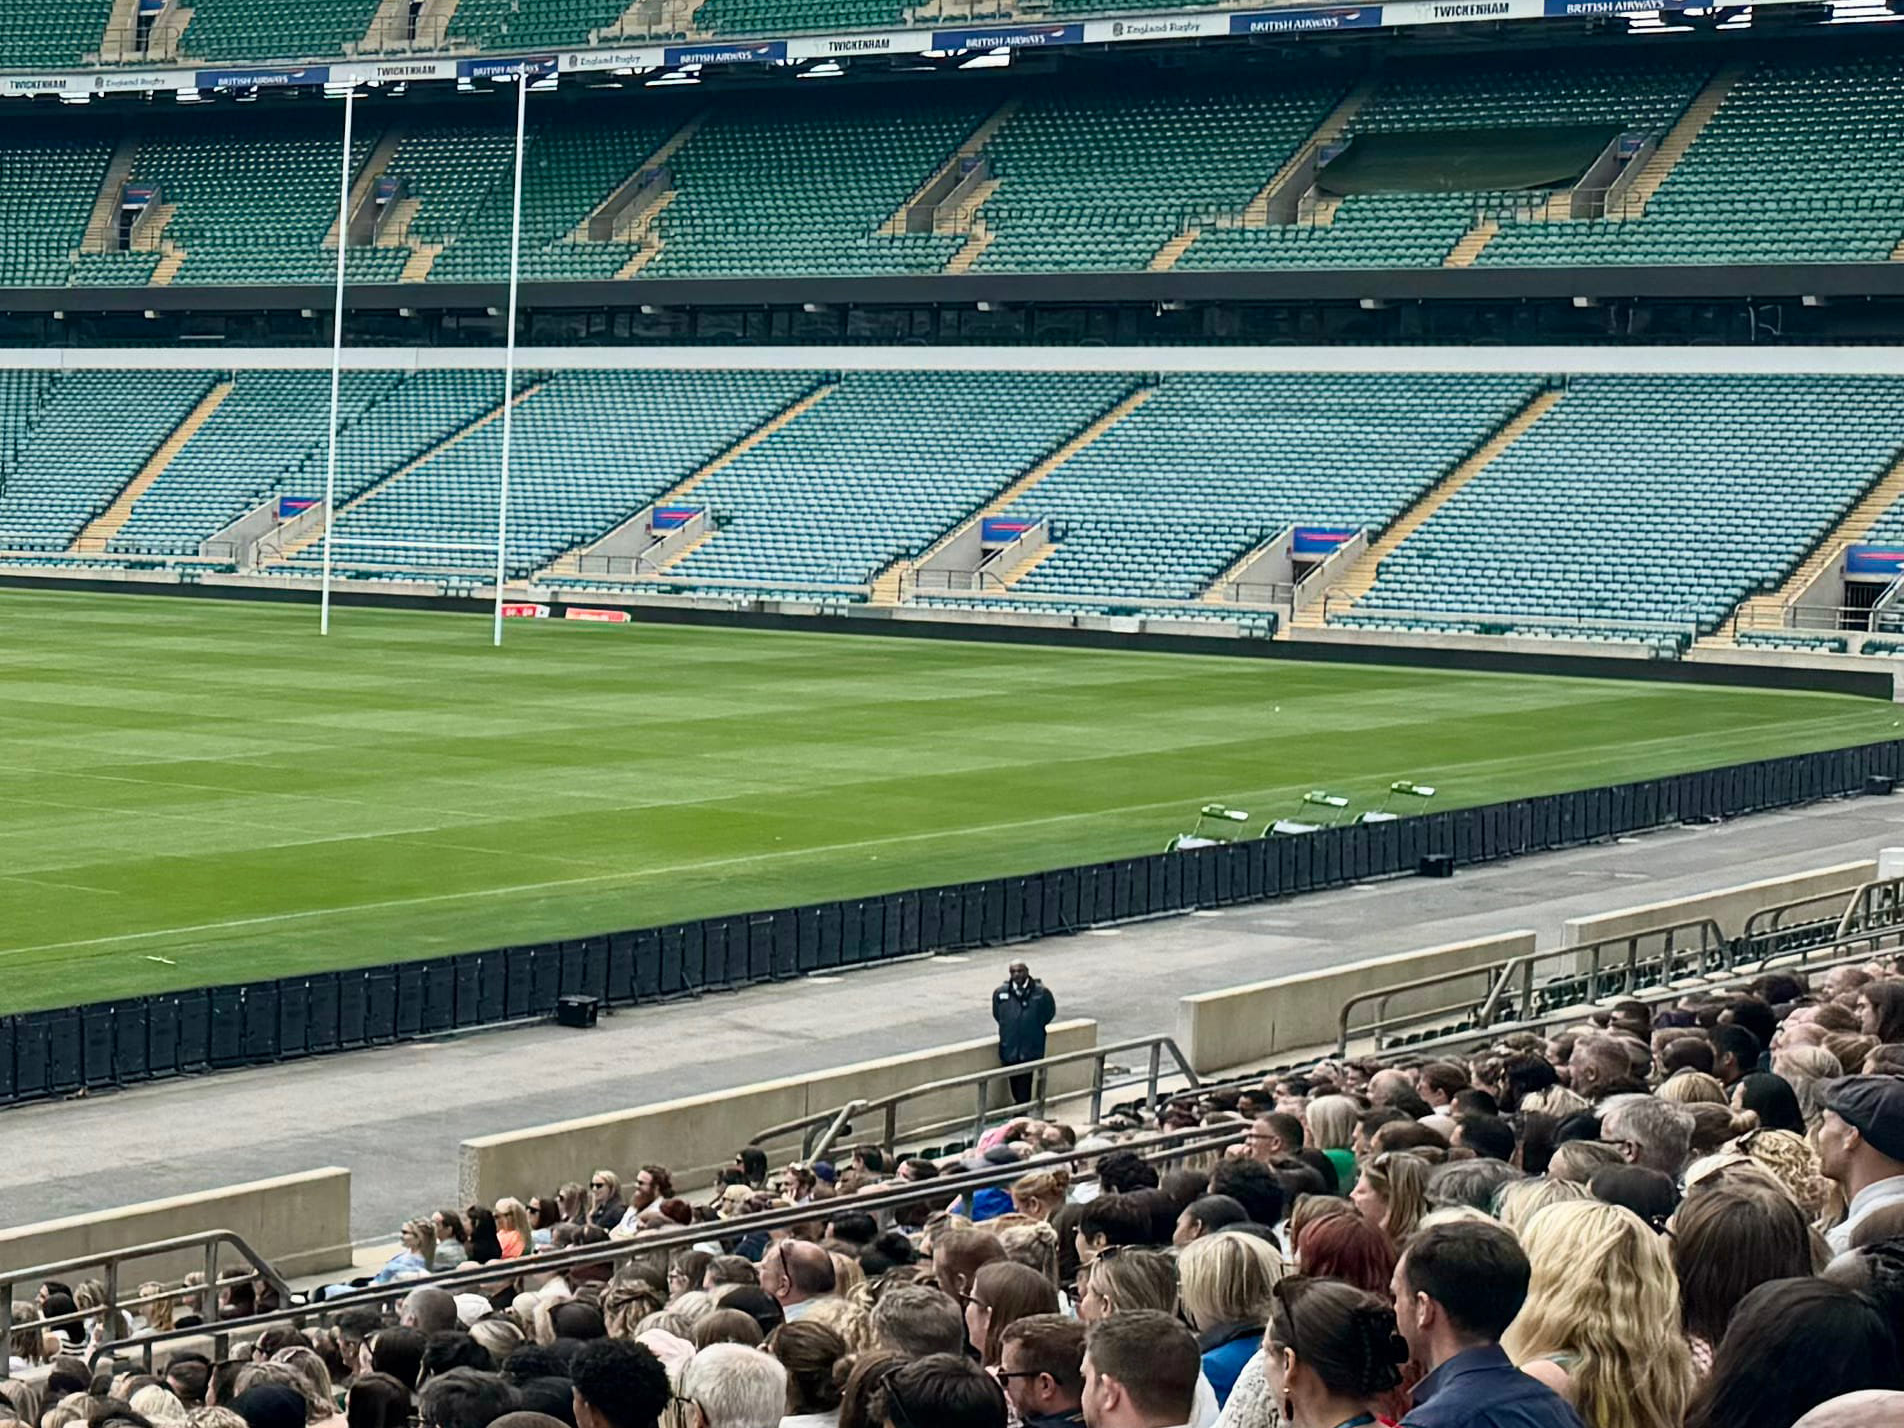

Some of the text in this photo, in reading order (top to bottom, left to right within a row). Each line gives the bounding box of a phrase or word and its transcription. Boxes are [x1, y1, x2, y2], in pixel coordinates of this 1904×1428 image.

[1434, 2, 1510, 19] TWICKENHAM
[1567, 1, 1613, 15] BRITISH
[1250, 16, 1339, 32] BRITISH AIRWAYS
[829, 38, 890, 53] TWICKENHAM
[965, 34, 1046, 50] BRITISH AIRWAYS
[680, 53, 715, 65] BRITISH
